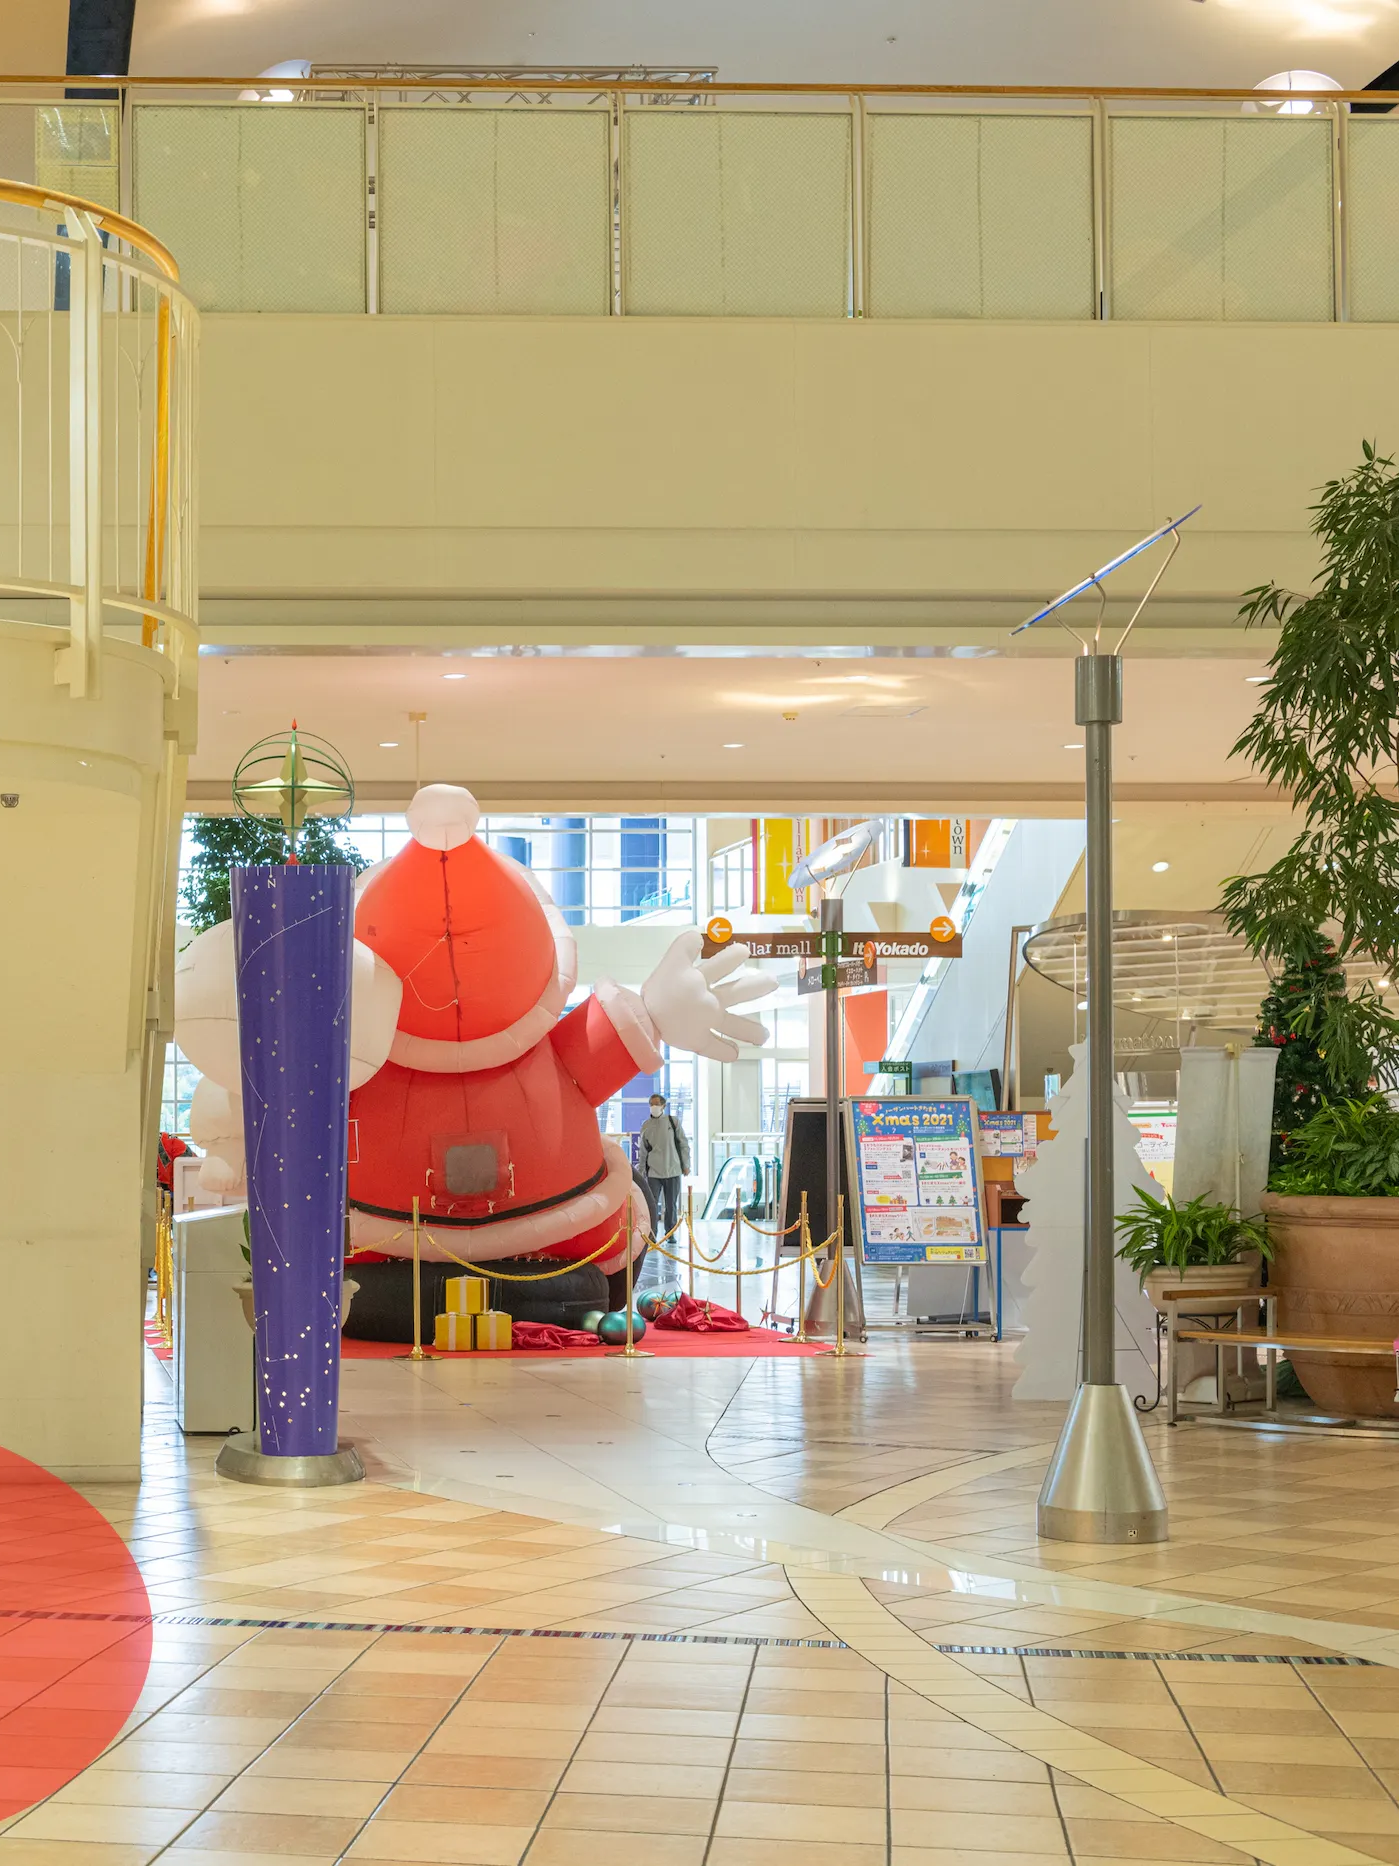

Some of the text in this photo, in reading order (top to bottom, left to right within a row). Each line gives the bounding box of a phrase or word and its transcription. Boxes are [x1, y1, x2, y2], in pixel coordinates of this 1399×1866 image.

[776, 940, 811, 955] mall
[875, 941, 929, 956] Yokado
[871, 1113, 954, 1126] Xmas 2021
